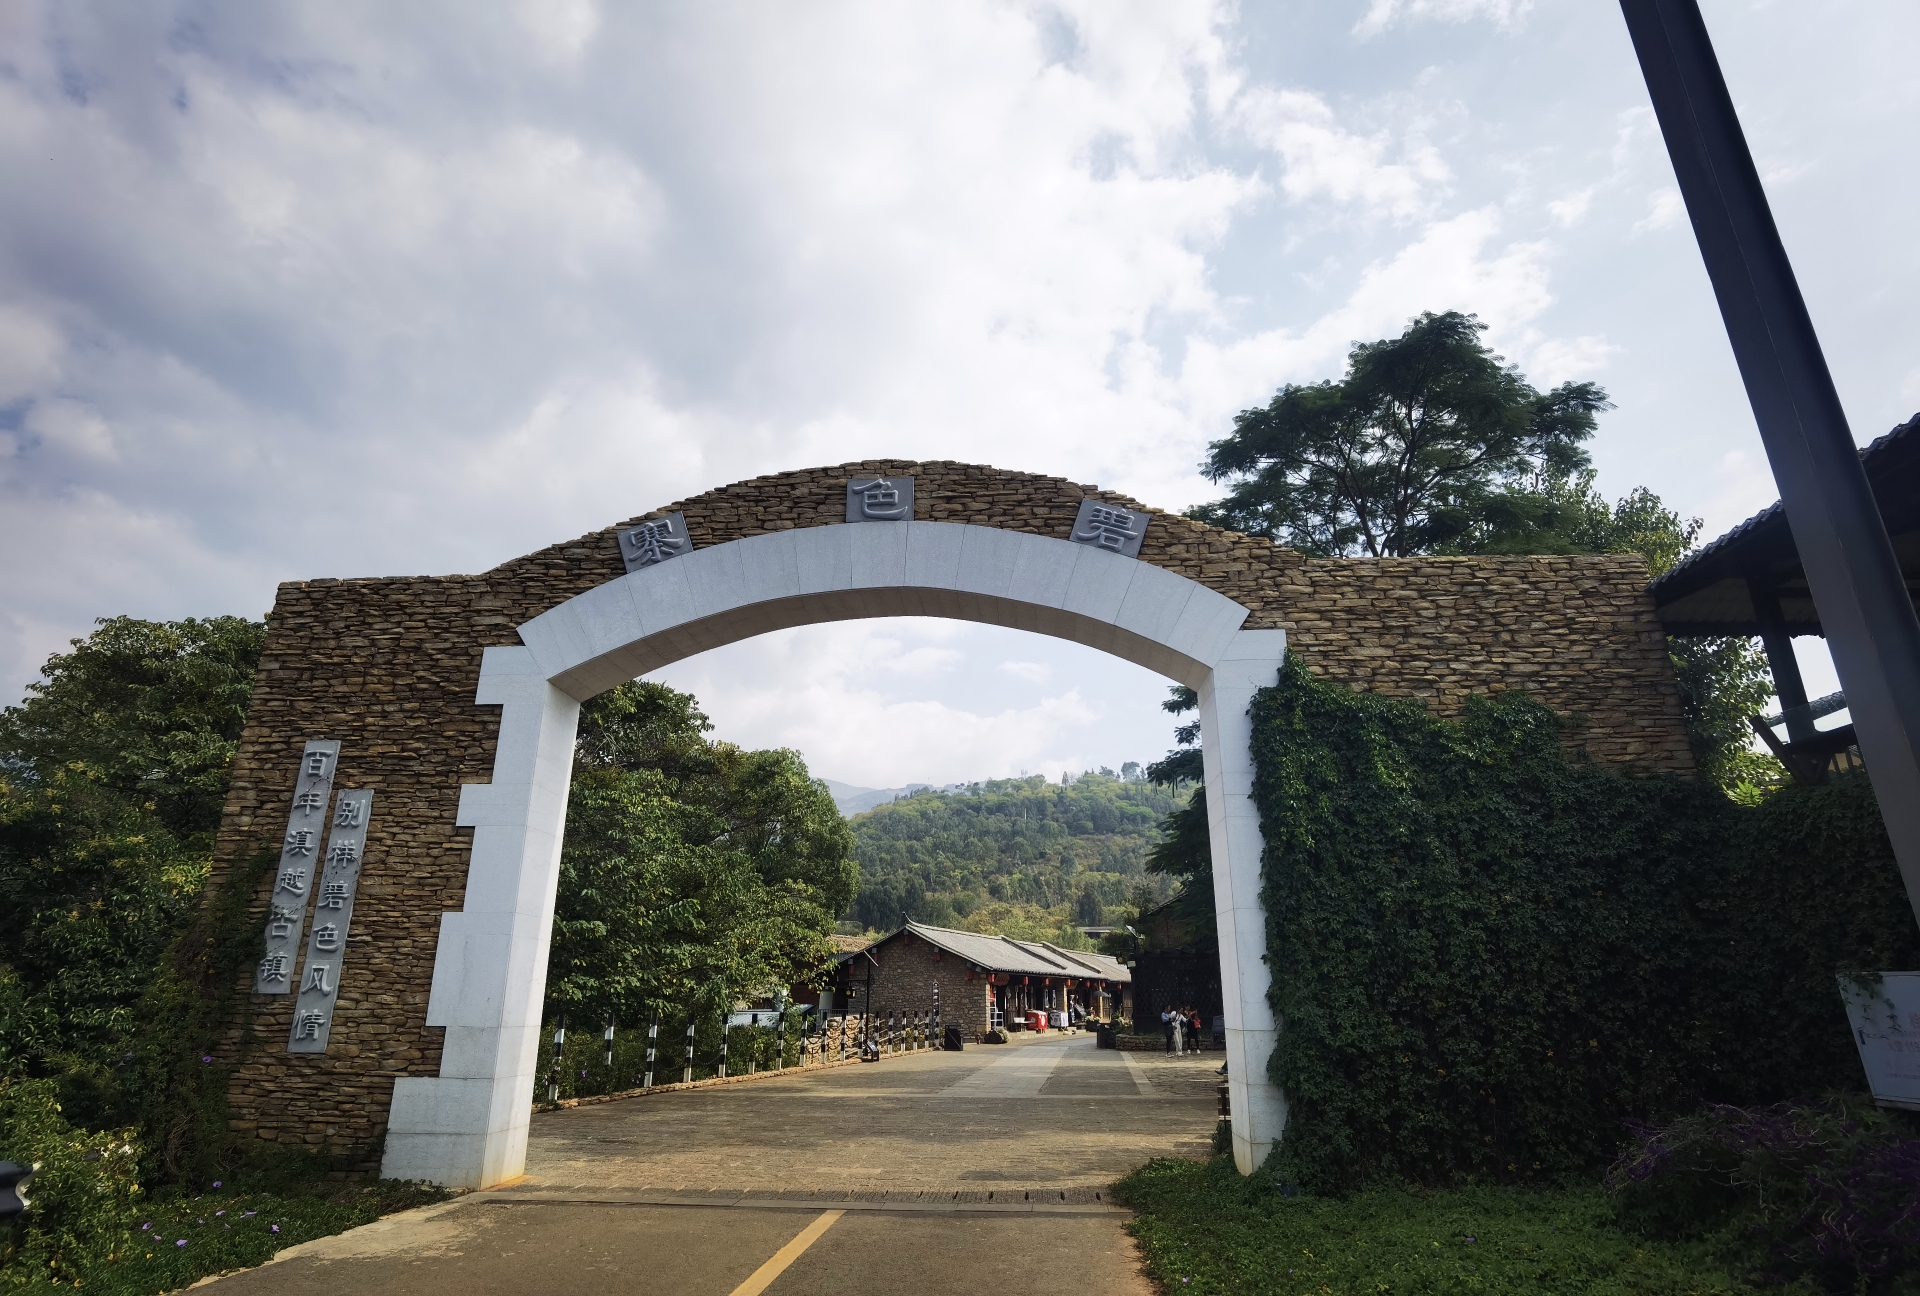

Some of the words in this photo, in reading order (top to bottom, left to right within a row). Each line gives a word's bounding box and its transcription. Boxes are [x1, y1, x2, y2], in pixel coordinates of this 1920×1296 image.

[259, 749, 334, 983] 百年滇越古镇
[293, 799, 366, 1040] 别样碧色风情
